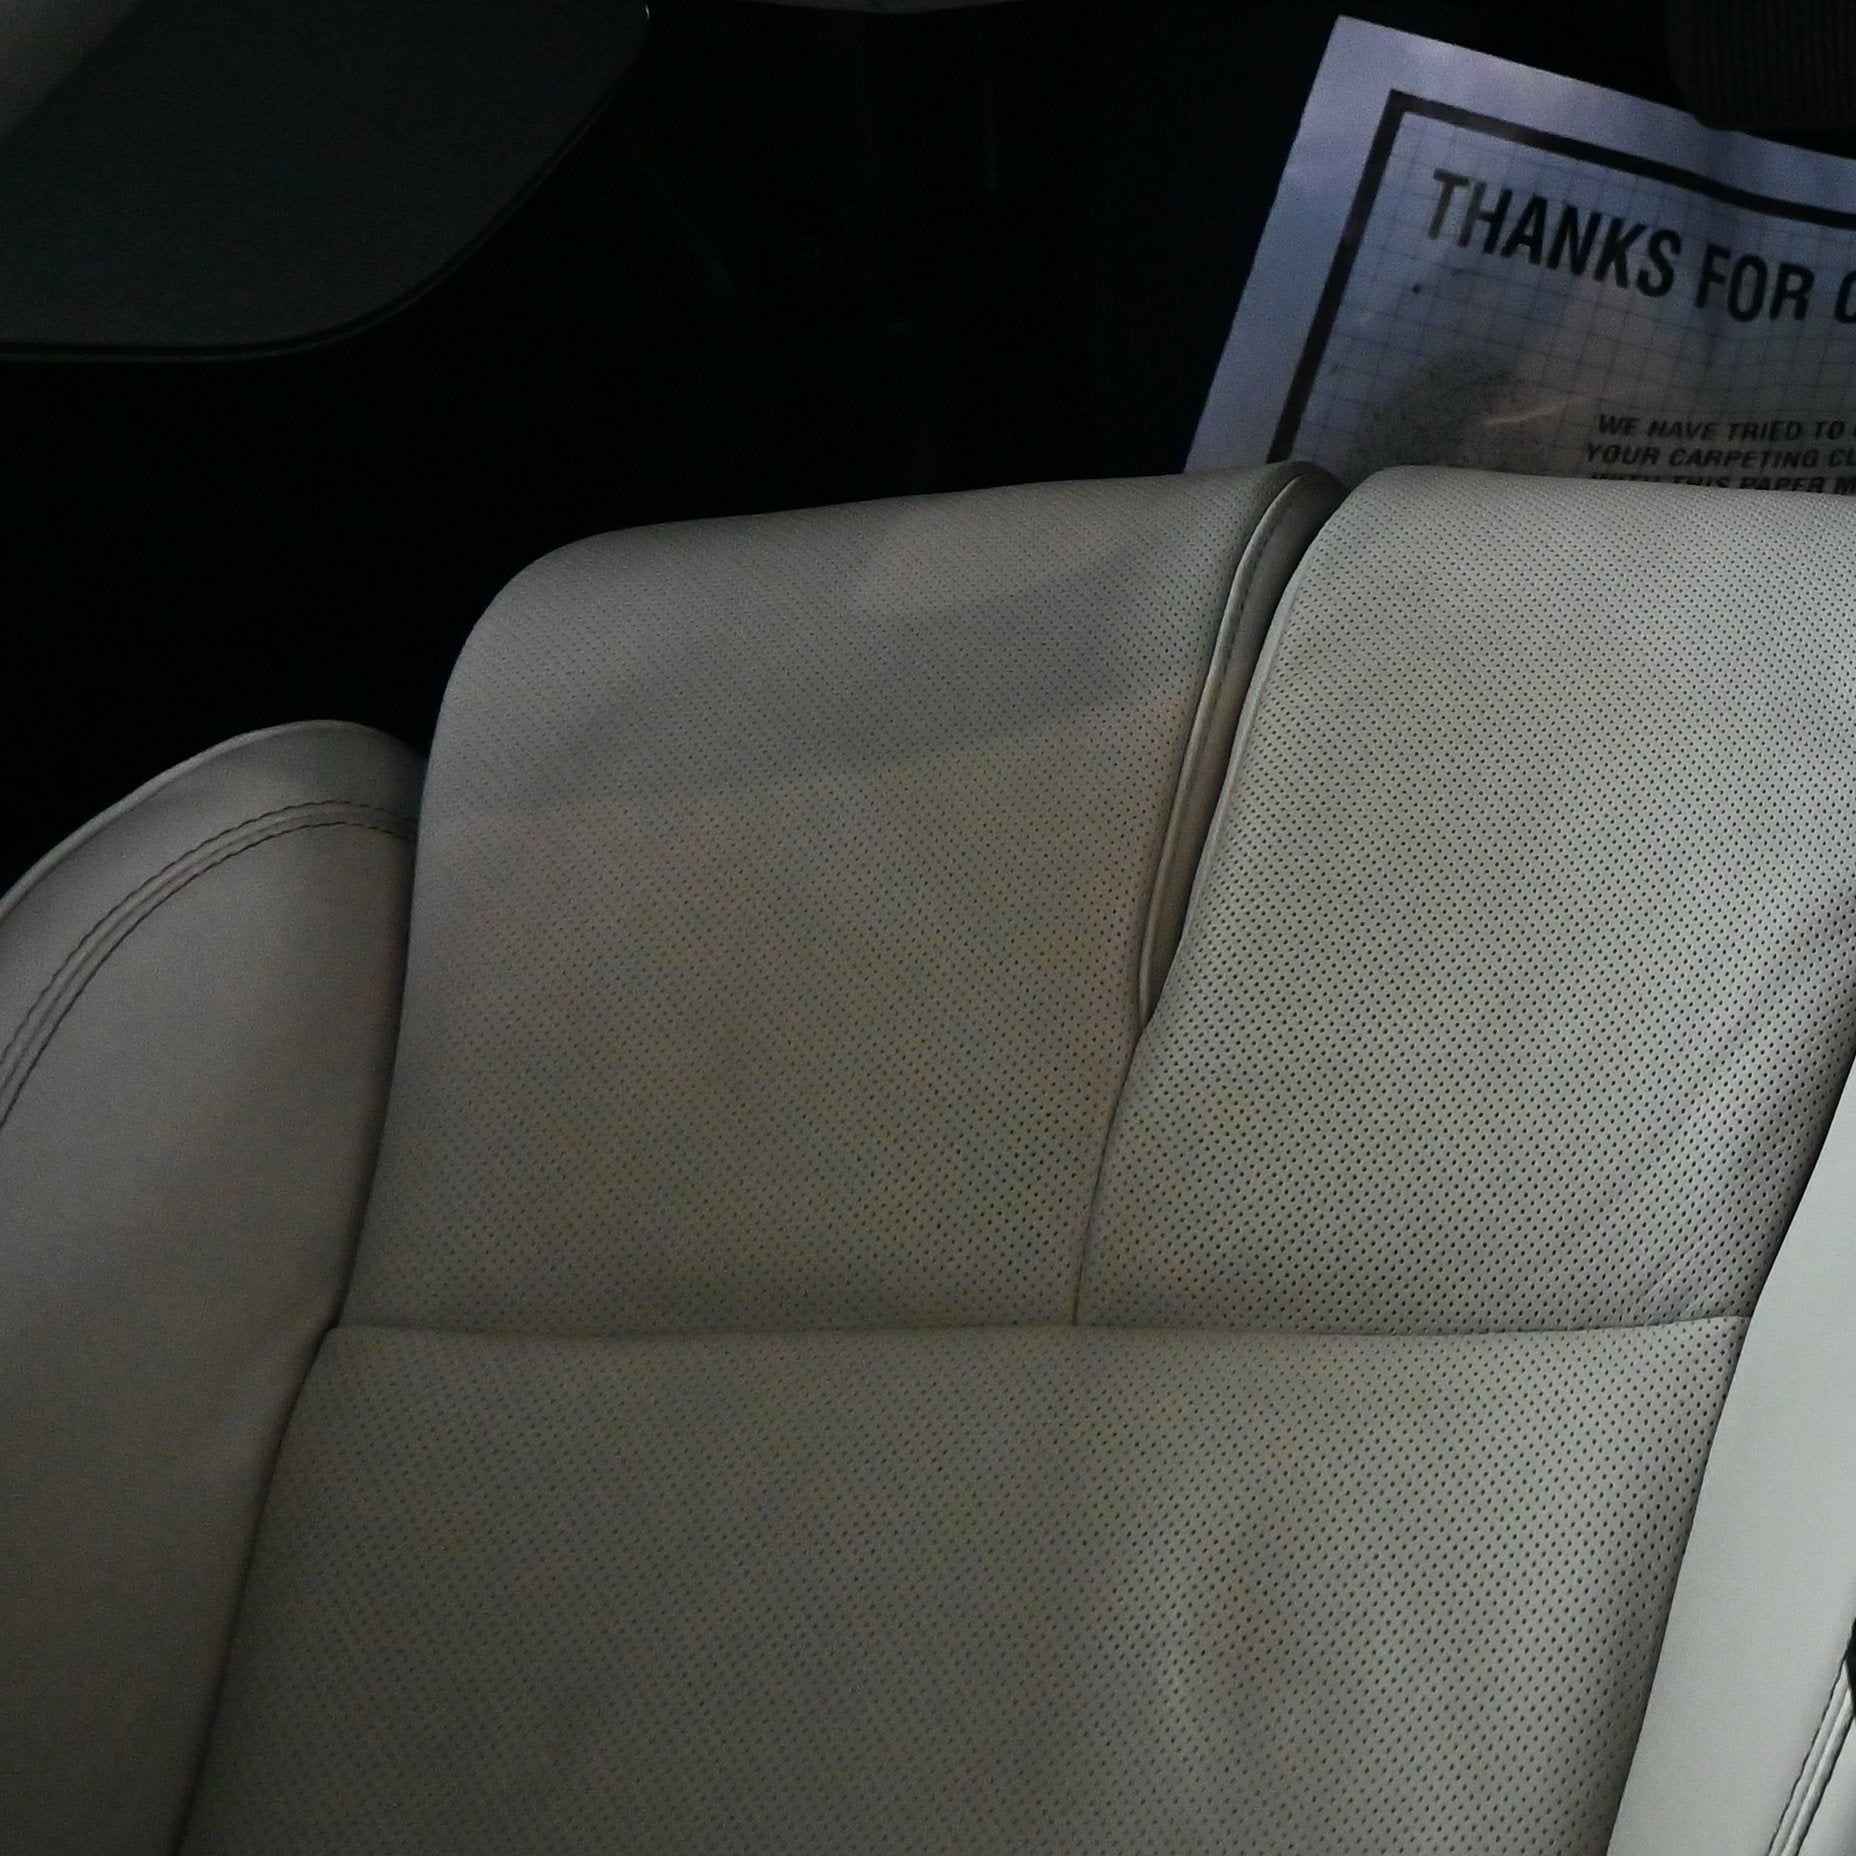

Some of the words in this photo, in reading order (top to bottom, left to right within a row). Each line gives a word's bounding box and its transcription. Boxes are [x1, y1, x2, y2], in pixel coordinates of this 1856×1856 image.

[1425, 167, 1682, 299] THANKS
[1695, 241, 1815, 324] FOR
[1597, 414, 1640, 436] WE
[1648, 419, 1719, 441] HAVE
[1727, 420, 1803, 442] TRIED
[1814, 420, 1845, 441] TO
[1585, 443, 1660, 467] YOUR
[1668, 446, 1820, 469] CARPETING
